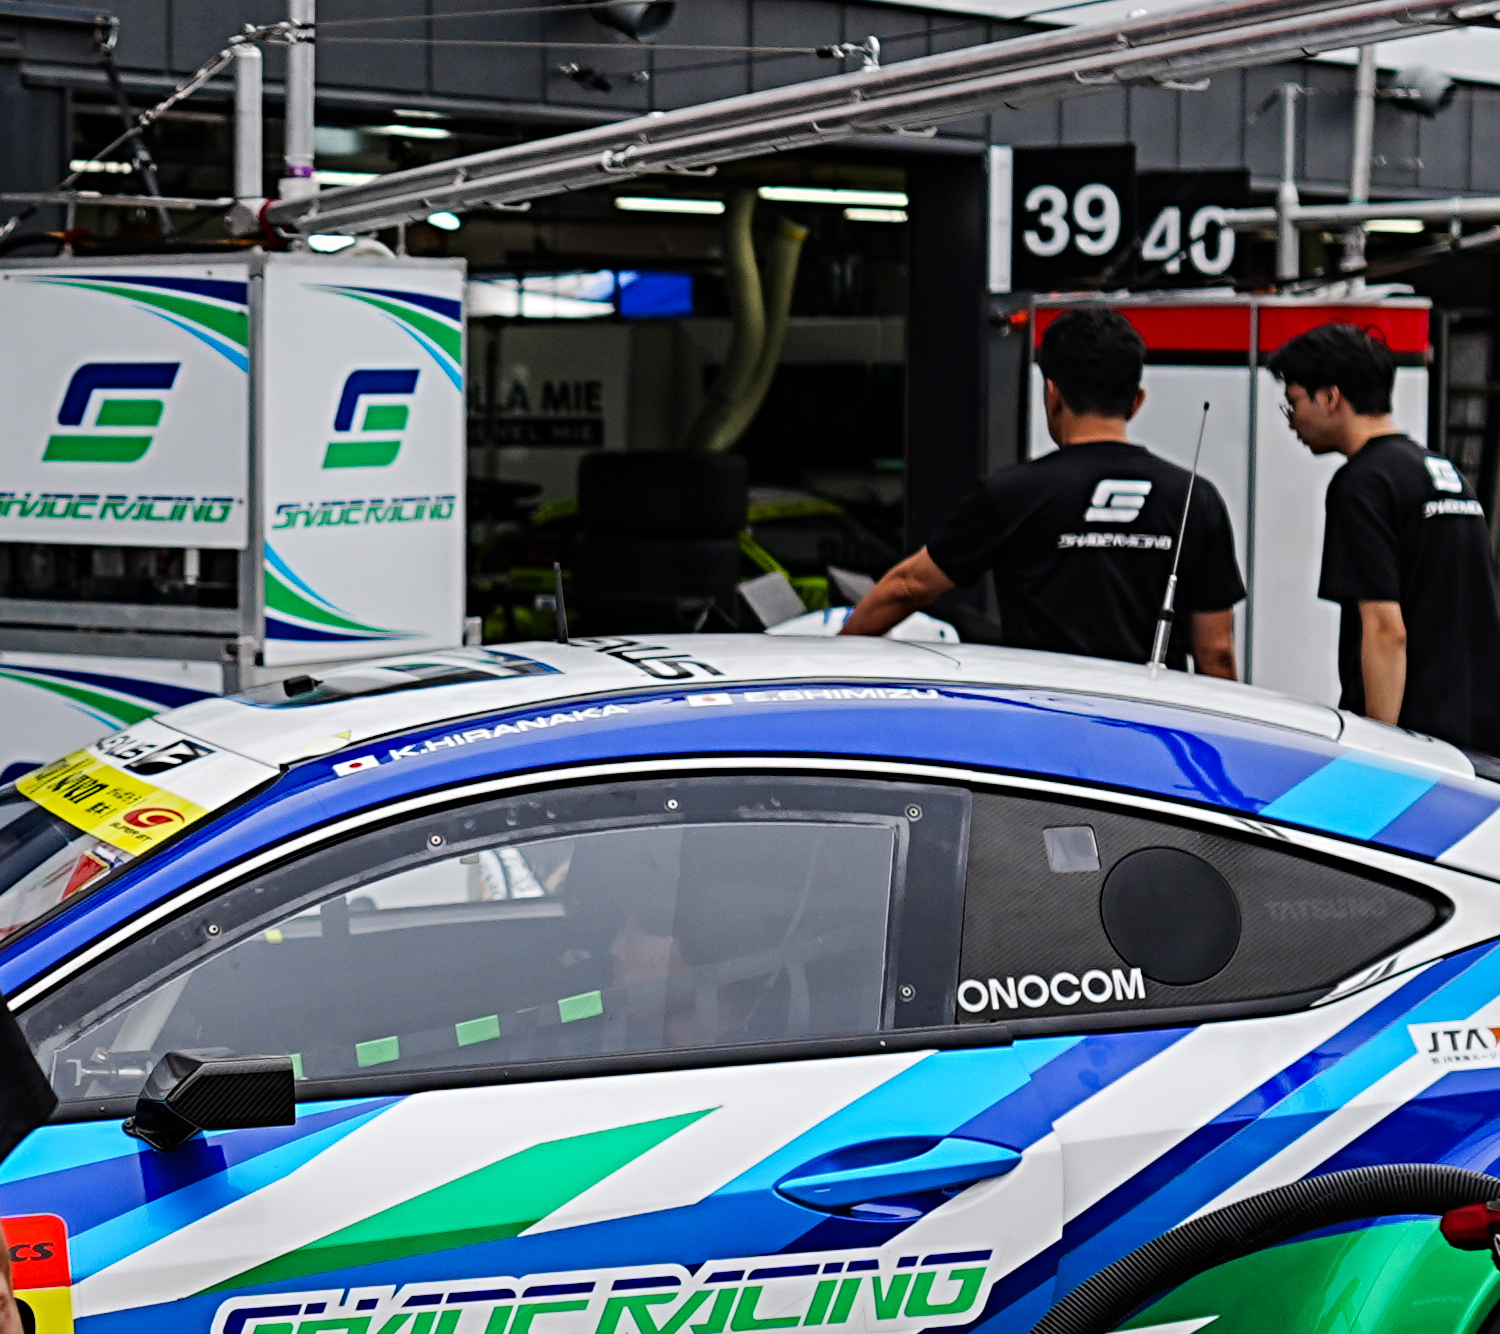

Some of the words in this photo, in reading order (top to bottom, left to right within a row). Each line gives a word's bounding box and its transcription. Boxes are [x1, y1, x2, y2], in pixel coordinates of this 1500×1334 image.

[1023, 184, 1121, 257] 39
[1142, 206, 1237, 276] 40
[99, 495, 234, 523] RACING
[389, 703, 630, 760] K.HIRANAKA
[958, 968, 1146, 1013] ONOCOM
[1428, 1028, 1488, 1053] JTA
